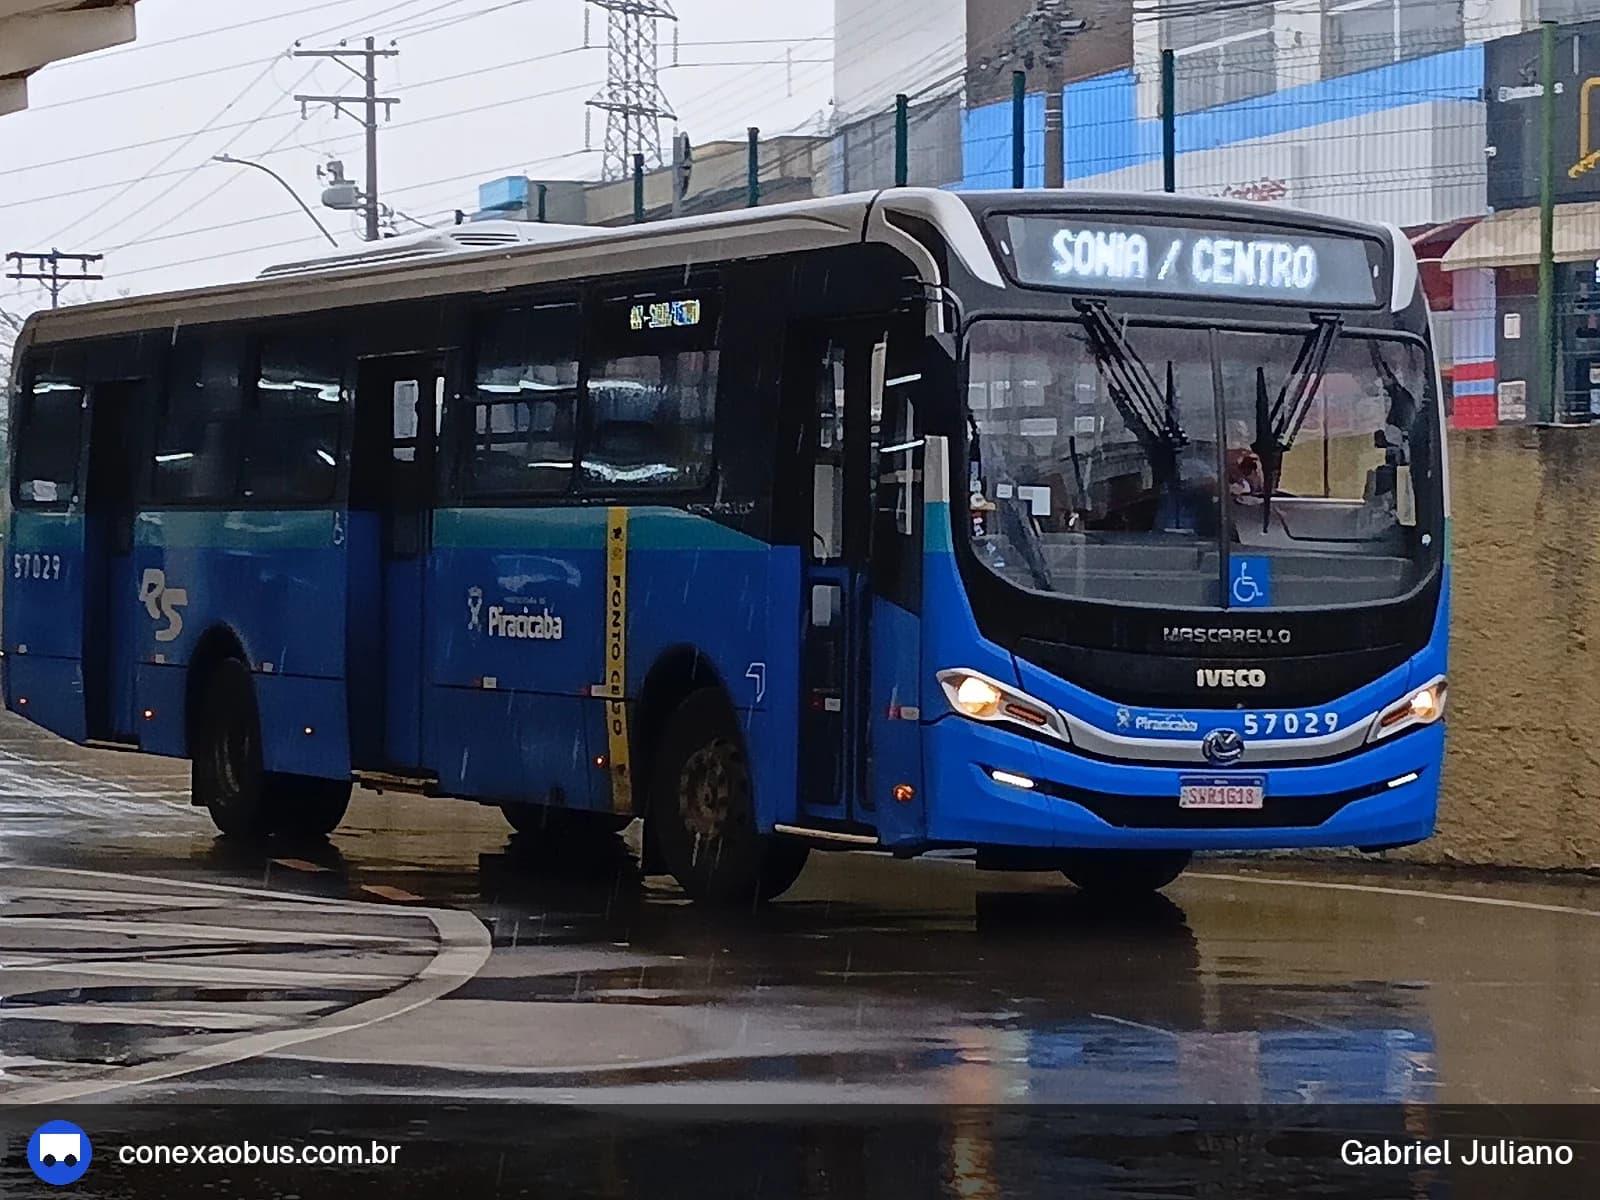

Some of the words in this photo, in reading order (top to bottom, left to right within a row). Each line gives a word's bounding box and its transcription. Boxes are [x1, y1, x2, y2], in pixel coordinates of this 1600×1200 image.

[1052, 228, 1148, 279] SONIA
[1192, 238, 1318, 288] CENTRO
[14, 553, 61, 580] 57029
[488, 606, 563, 640] Piracicaba
[1163, 627, 1291, 643] MASCARELLO
[1196, 668, 1267, 687] IVECO
[1244, 712, 1339, 735] 57029
